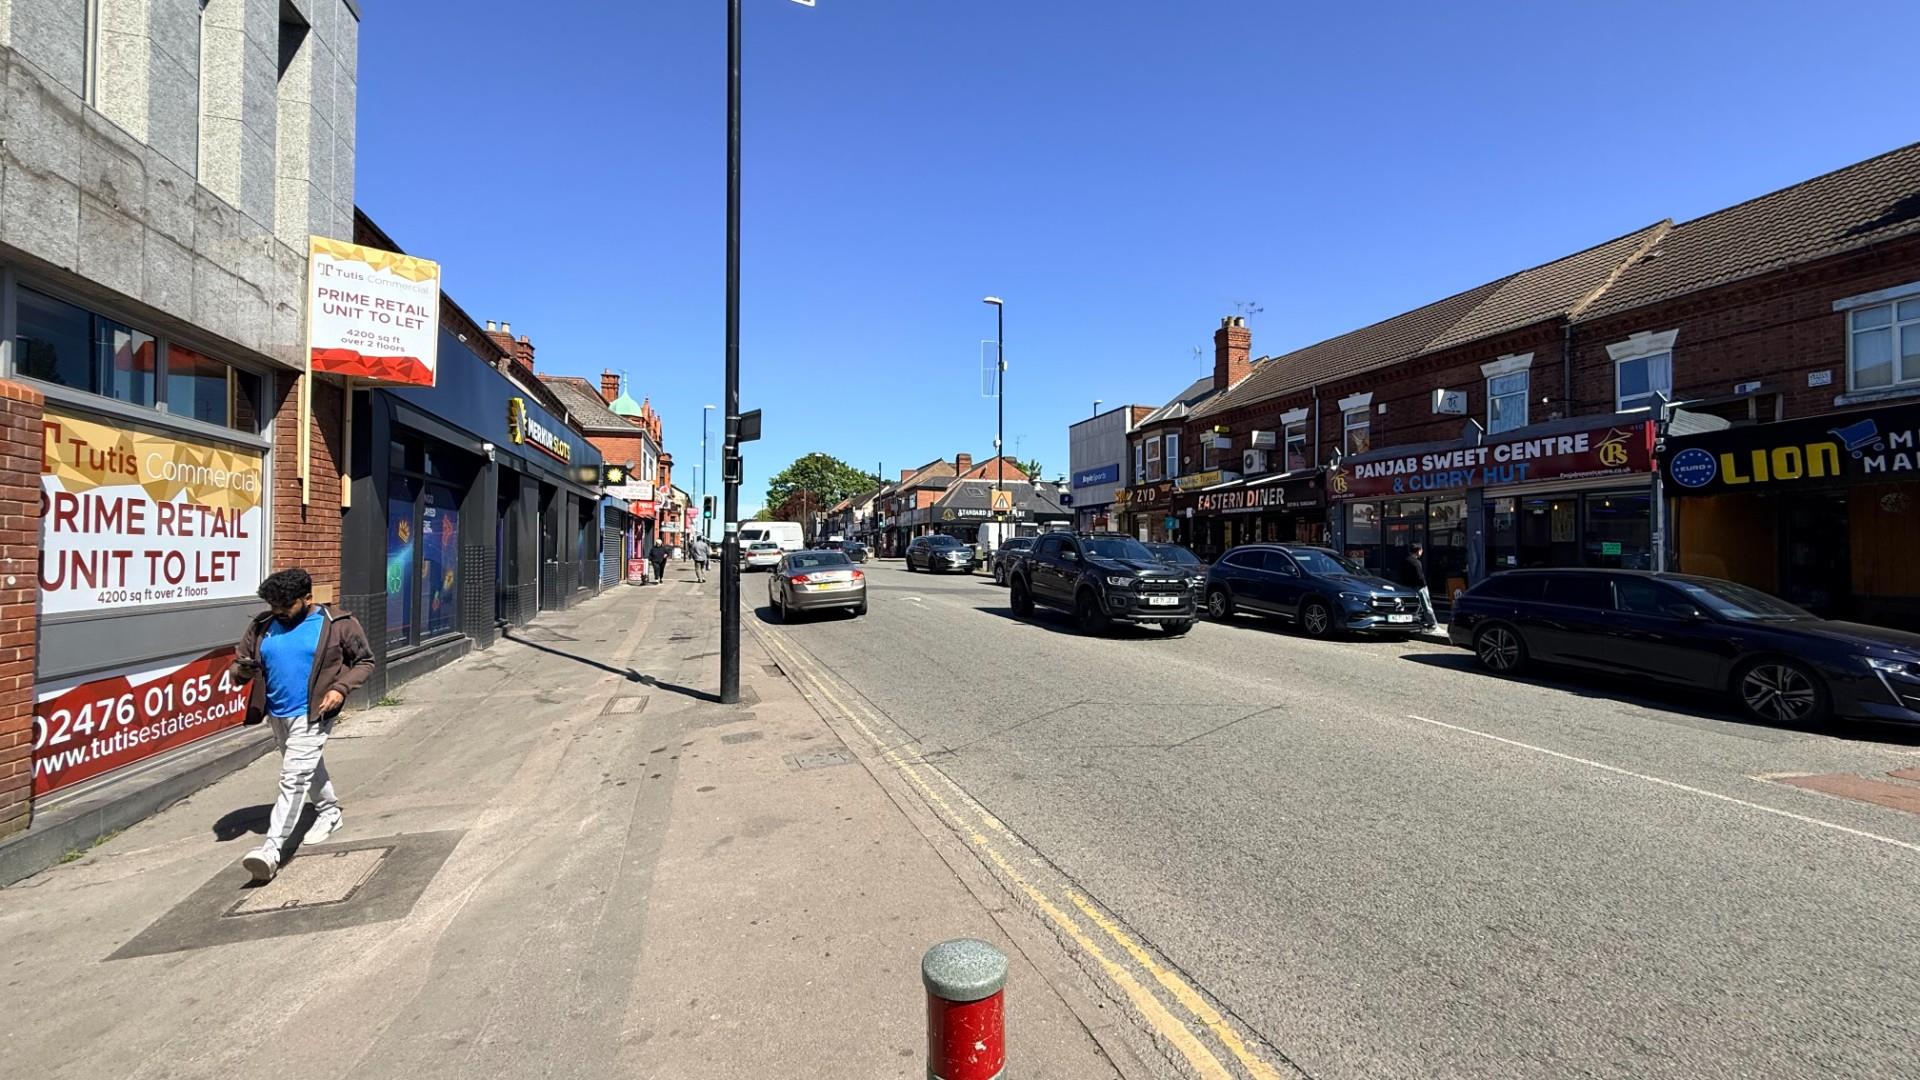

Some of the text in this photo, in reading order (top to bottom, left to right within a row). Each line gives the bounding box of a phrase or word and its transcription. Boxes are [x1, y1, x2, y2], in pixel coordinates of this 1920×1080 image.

[336, 268, 429, 294] Tutis Commercial
[318, 287, 430, 318] PRIME RETAIL
[323, 303, 424, 330] UNIT TO LET
[341, 337, 405, 352] over 2 floors
[347, 329, 401, 344] 4200 sq ft
[1889, 429, 1920, 450] M
[69, 438, 259, 493] Tutis Commercial
[1355, 433, 1589, 480] PANJAB SWEET CENTRE
[1680, 463, 1706, 473] EURO
[1392, 462, 1530, 494] & CURRY HUT
[1136, 488, 1155, 503] ZYD
[1198, 492, 1244, 511] EASTERN
[1247, 487, 1285, 507] DINER
[156, 501, 249, 539] RETAIL
[37, 549, 240, 592] UNIT TO LET
[97, 586, 208, 604] 4200 sq ft over 2 floors
[32, 693, 135, 750] 02476
[144, 683, 174, 717] 01
[182, 674, 211, 706] 65
